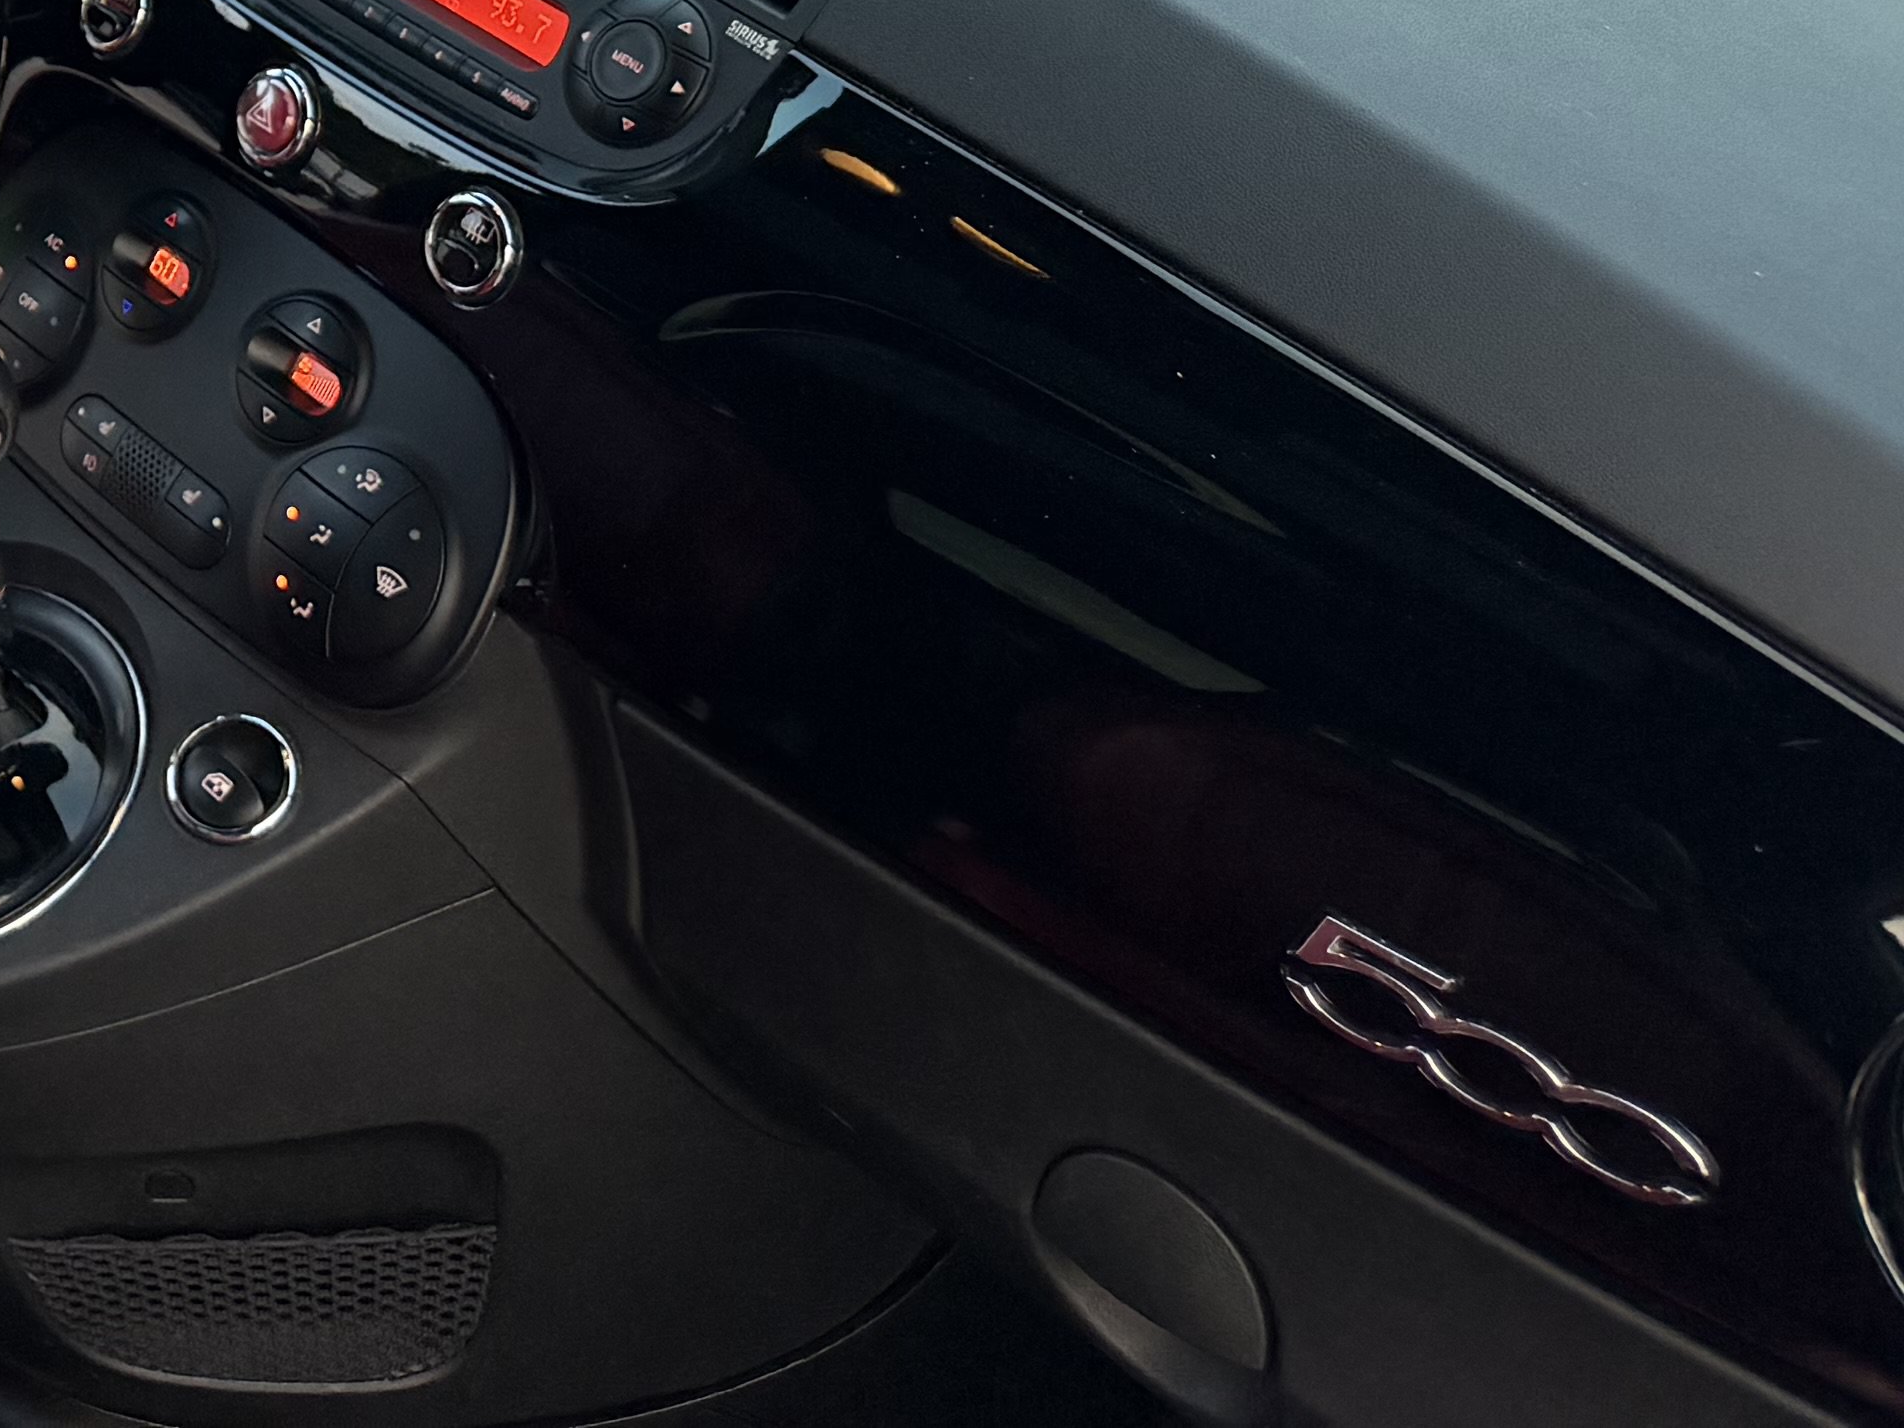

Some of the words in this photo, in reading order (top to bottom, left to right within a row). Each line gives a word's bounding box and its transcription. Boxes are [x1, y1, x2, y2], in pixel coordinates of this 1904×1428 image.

[731, 20, 768, 48] SIRIUS
[611, 49, 644, 74] MENU
[149, 248, 180, 283] 60
[19, 292, 40, 313] OFF
[1280, 913, 1721, 1208] 500
